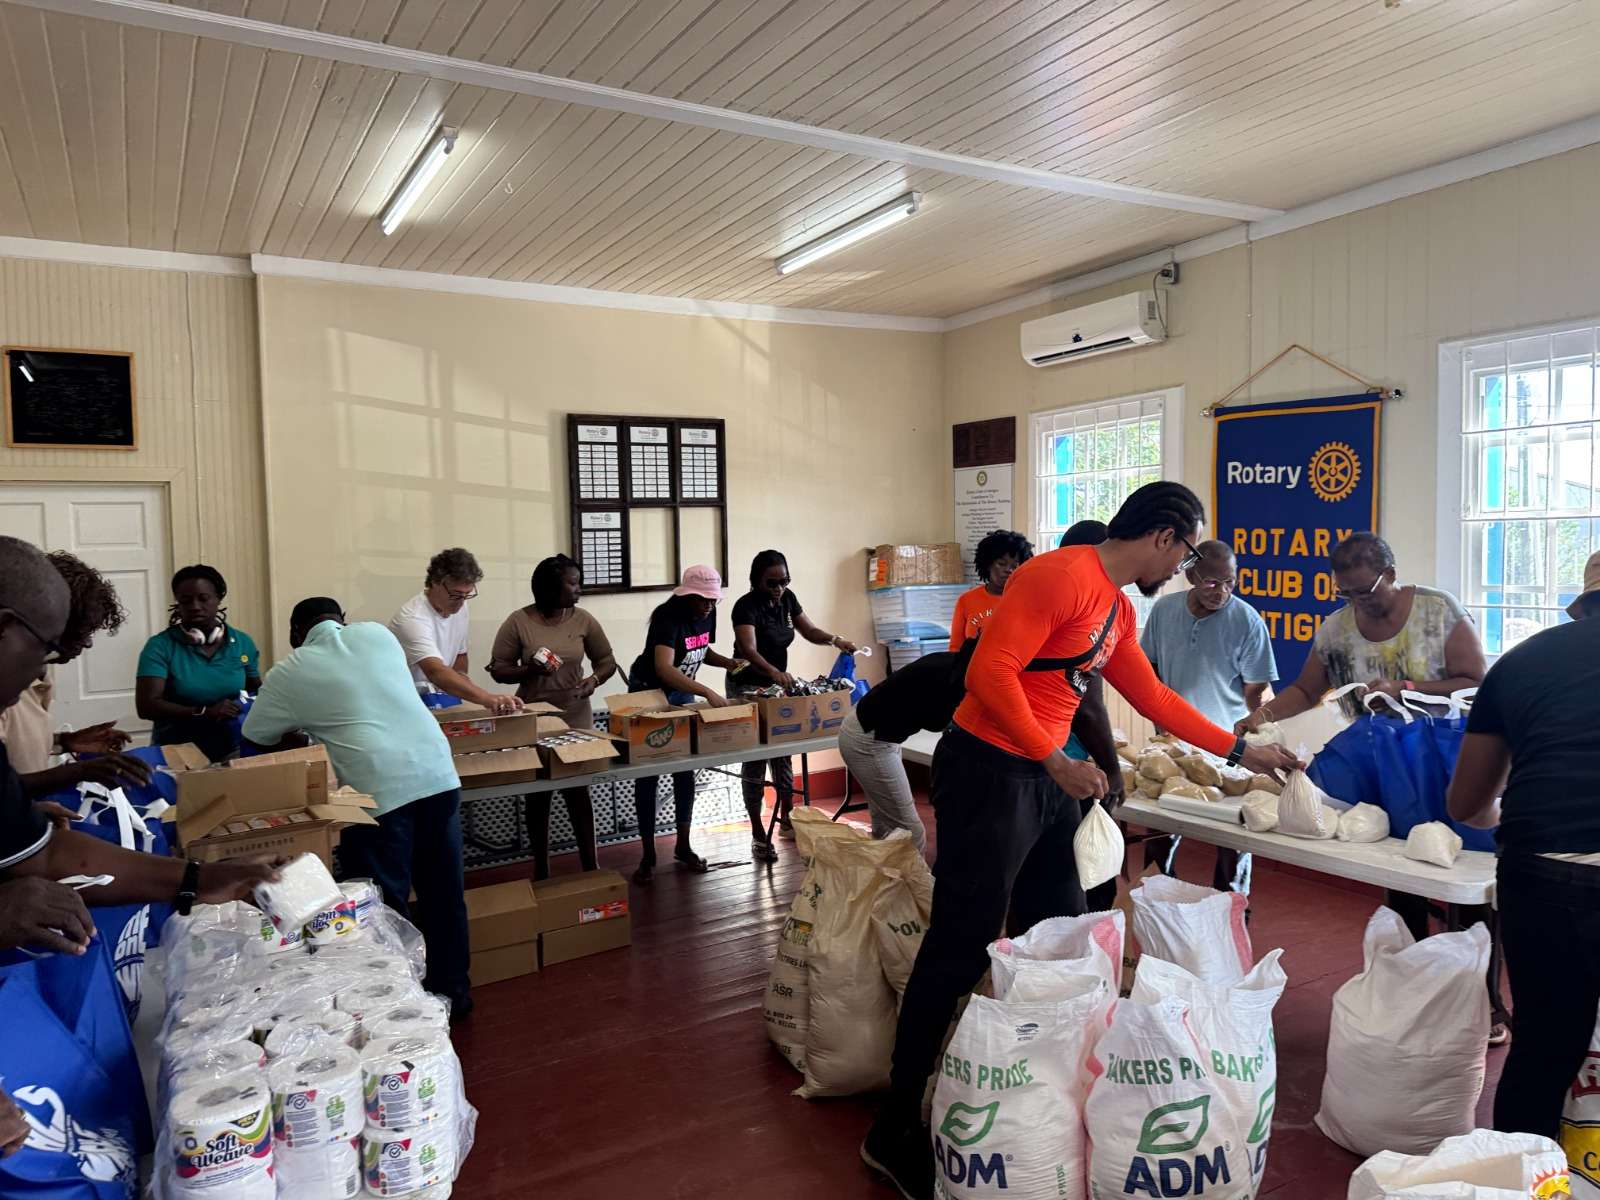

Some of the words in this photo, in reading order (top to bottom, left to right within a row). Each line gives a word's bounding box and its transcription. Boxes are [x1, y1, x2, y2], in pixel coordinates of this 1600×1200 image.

[1227, 462, 1301, 489] Rotary
[1239, 568, 1303, 599] CLUB
[1261, 610, 1322, 641] TIG
[772, 983, 793, 997] ASR
[943, 1053, 972, 1085] ERS
[977, 1058, 1034, 1091] PRIDE
[191, 1144, 254, 1168] Weave
[206, 1133, 236, 1153] Soft
[935, 1135, 1009, 1189] ADM
[1123, 1145, 1231, 1198] ADM
